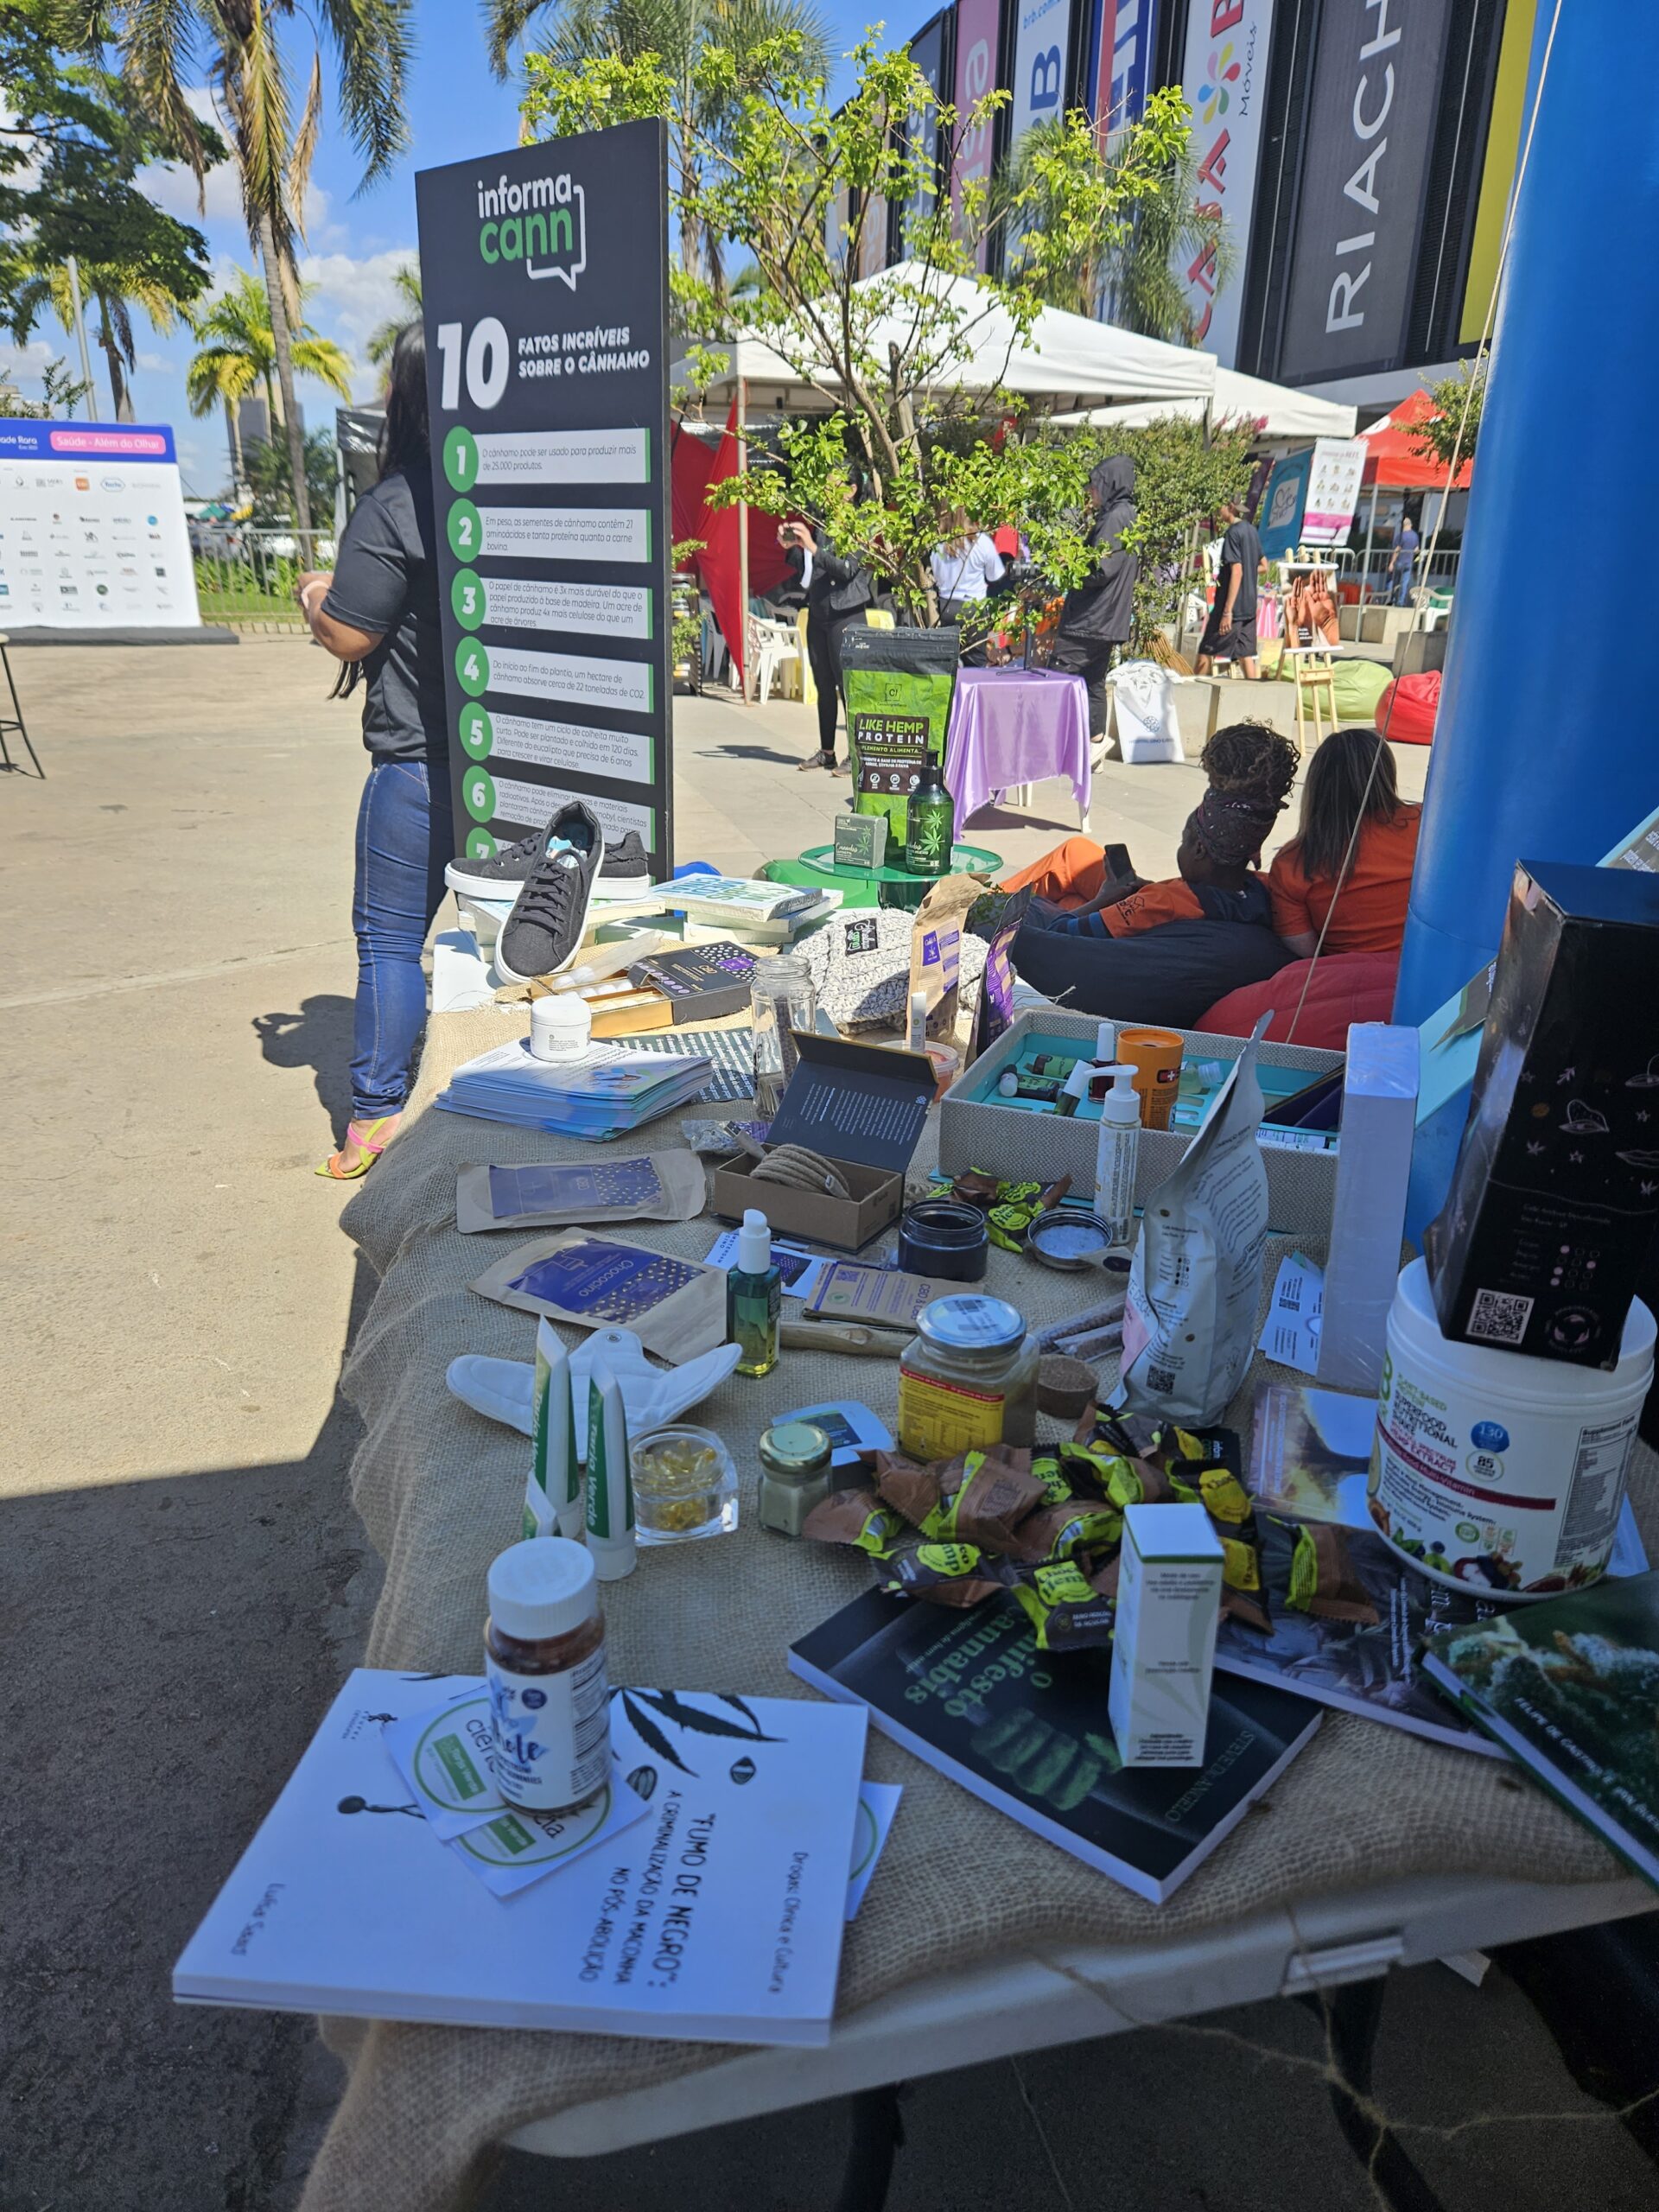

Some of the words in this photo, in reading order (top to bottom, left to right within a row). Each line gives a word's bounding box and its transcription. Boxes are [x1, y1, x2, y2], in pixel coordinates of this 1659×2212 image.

[1238, 22, 1258, 117] Móveis
[479, 173, 572, 218] informa
[480, 208, 573, 264] cann
[518, 334, 560, 356] FATOS
[562, 325, 631, 351] INCRÍVEIS
[437, 316, 510, 410] 10
[518, 358, 563, 378] SOBRE
[564, 356, 575, 375] O
[578, 350, 650, 373] CÂNHAMO
[456, 446, 467, 476] 1
[488, 448, 519, 458] cânhamo
[520, 448, 537, 459] pode
[537, 448, 548, 457] ser
[548, 447, 570, 457] usado
[570, 448, 588, 459] para
[588, 446, 617, 459] produzir
[619, 444, 637, 455] mais
[482, 461, 491, 471] de
[491, 461, 512, 472] 25.000
[458, 516, 474, 546] 2
[486, 516, 496, 526] Em
[497, 518, 513, 529] peso,
[513, 518, 522, 527] as
[522, 518, 554, 527] sementes
[554, 518, 563, 528] de
[563, 518, 597, 529] cânhamo
[597, 518, 625, 530] contêm
[486, 530, 526, 540] aminoácidos
[531, 531, 550, 541] tanta
[550, 531, 579, 543] proteína
[579, 532, 605, 544] quanto
[612, 535, 633, 543] carne
[461, 586, 476, 615] 3
[489, 593, 507, 604] papel
[507, 594, 539, 607] produzido
[545, 596, 562, 607] base
[562, 597, 571, 607] de
[571, 598, 602, 610] madeira.
[603, 600, 615, 610] Um
[616, 602, 632, 611] acre
[632, 601, 643, 613] de
[494, 582, 513, 593] papel
[513, 582, 522, 592] de
[522, 582, 554, 595] cânhamo
[568, 586, 585, 597] mais
[585, 587, 612, 599] durável
[612, 588, 622, 599] do
[622, 591, 637, 602] que
[490, 603, 519, 614] cânhamo
[520, 605, 542, 618] produz
[551, 607, 569, 619] mais
[568, 608, 595, 621] celulose
[595, 611, 606, 621] do
[606, 613, 620, 624] que
[620, 614, 633, 624] um
[490, 615, 505, 625] acre
[504, 615, 513, 625] de
[463, 653, 480, 682] 4
[493, 659, 502, 670] Do
[502, 661, 519, 671] início
[519, 664, 528, 672] ao
[528, 664, 540, 674] fim
[540, 664, 550, 675] do
[550, 665, 574, 679] plantio,
[574, 670, 587, 679] um
[587, 670, 613, 683] hectare
[613, 673, 623, 683] de
[493, 671, 523, 683] cânhamo
[523, 675, 548, 687] absorve
[548, 680, 566, 689] cerca
[567, 680, 575, 690] de
[575, 682, 584, 691] 22
[585, 683, 619, 696] toneladas
[619, 685, 629, 697] de
[469, 719, 484, 746] 5
[501, 715, 531, 728] cânhamo
[531, 719, 544, 729] tem
[544, 722, 556, 732] um
[556, 724, 571, 735] ciclo
[571, 725, 581, 737] de
[582, 727, 607, 741] colheita
[608, 731, 629, 744] muito
[857, 731, 925, 745] PROTEIN
[859, 718, 884, 733] LIKE
[886, 721, 925, 734] HEMP
[496, 735, 524, 748] Diferente
[524, 741, 533, 750] do
[533, 741, 563, 756] eucalipto
[563, 747, 575, 759] que
[575, 748, 600, 762] precisa
[600, 752, 609, 763] de
[615, 757, 632, 768] anos
[513, 728, 530, 740] Pode
[530, 731, 540, 741] ser
[539, 732, 569, 746] plantado
[575, 737, 600, 751] colhido
[599, 742, 611, 752] em
[611, 743, 622, 754] 120
[861, 745, 889, 753] PLEMENTO
[889, 746, 923, 754] ALIMENTA
[497, 747, 512, 758] para
[512, 749, 533, 761] crescer
[538, 753, 553, 764] virar
[472, 781, 486, 808] 6
[505, 782, 531, 793] cânhamo
[531, 787, 546, 797] pode
[599, 801, 628, 813] materiais
[617, 815, 647, 828] cientistas
[578, 1259, 634, 1297] Chococino
[1478, 1423, 1503, 1440] 130
[587, 1423, 598, 1472] Tarja
[1477, 1455, 1495, 1469] 85
[588, 1475, 597, 1527] Verde
[940, 1634, 1040, 1721] nifesto
[1026, 1666, 1056, 1694] O
[1512, 1694, 1550, 1729] FELIPE
[1543, 1721, 1565, 1743] DE
[668, 1789, 685, 1802] A
[639, 1799, 684, 1898] CRIMINALIZAÇÃO
[611, 1865, 633, 1888] NO
[671, 1870, 705, 1903] DE
[633, 1898, 656, 1920] DA
[613, 1919, 651, 1989] MACONHA
